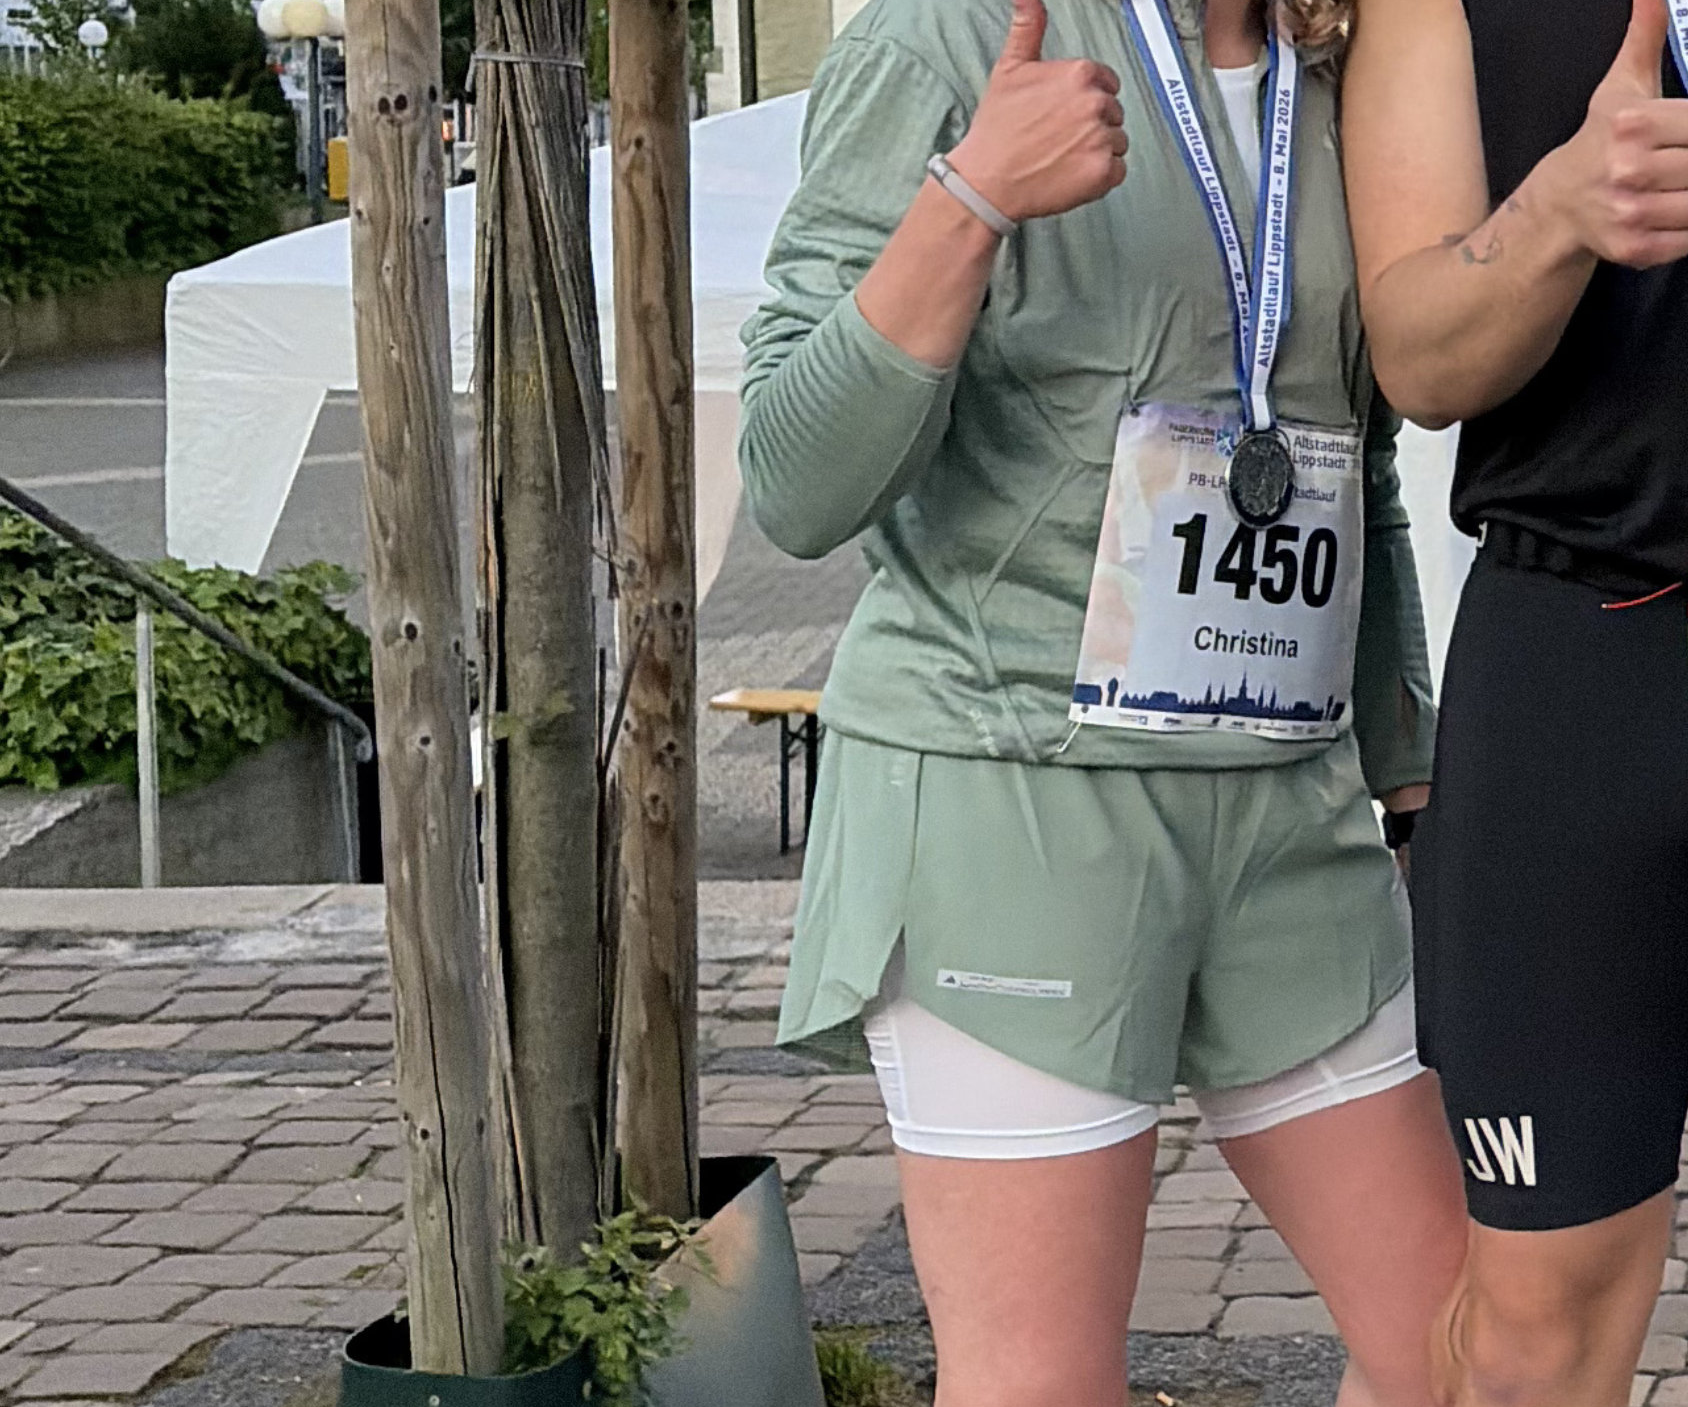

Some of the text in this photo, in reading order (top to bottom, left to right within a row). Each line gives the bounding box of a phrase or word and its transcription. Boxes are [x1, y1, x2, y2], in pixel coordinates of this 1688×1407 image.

[1277, 89, 1291, 124] 2026
[1166, 78, 1212, 173] Altstadtlauf
[1206, 176, 1237, 252] Lippstadt
[1267, 193, 1285, 267] Lippstadt
[1257, 271, 1280, 368] Altstadtlauf
[1292, 450, 1347, 469] Lippstadt
[1172, 513, 1338, 608] 1450
[1194, 625, 1299, 659] Christina
[1464, 1115, 1537, 1187] JW
